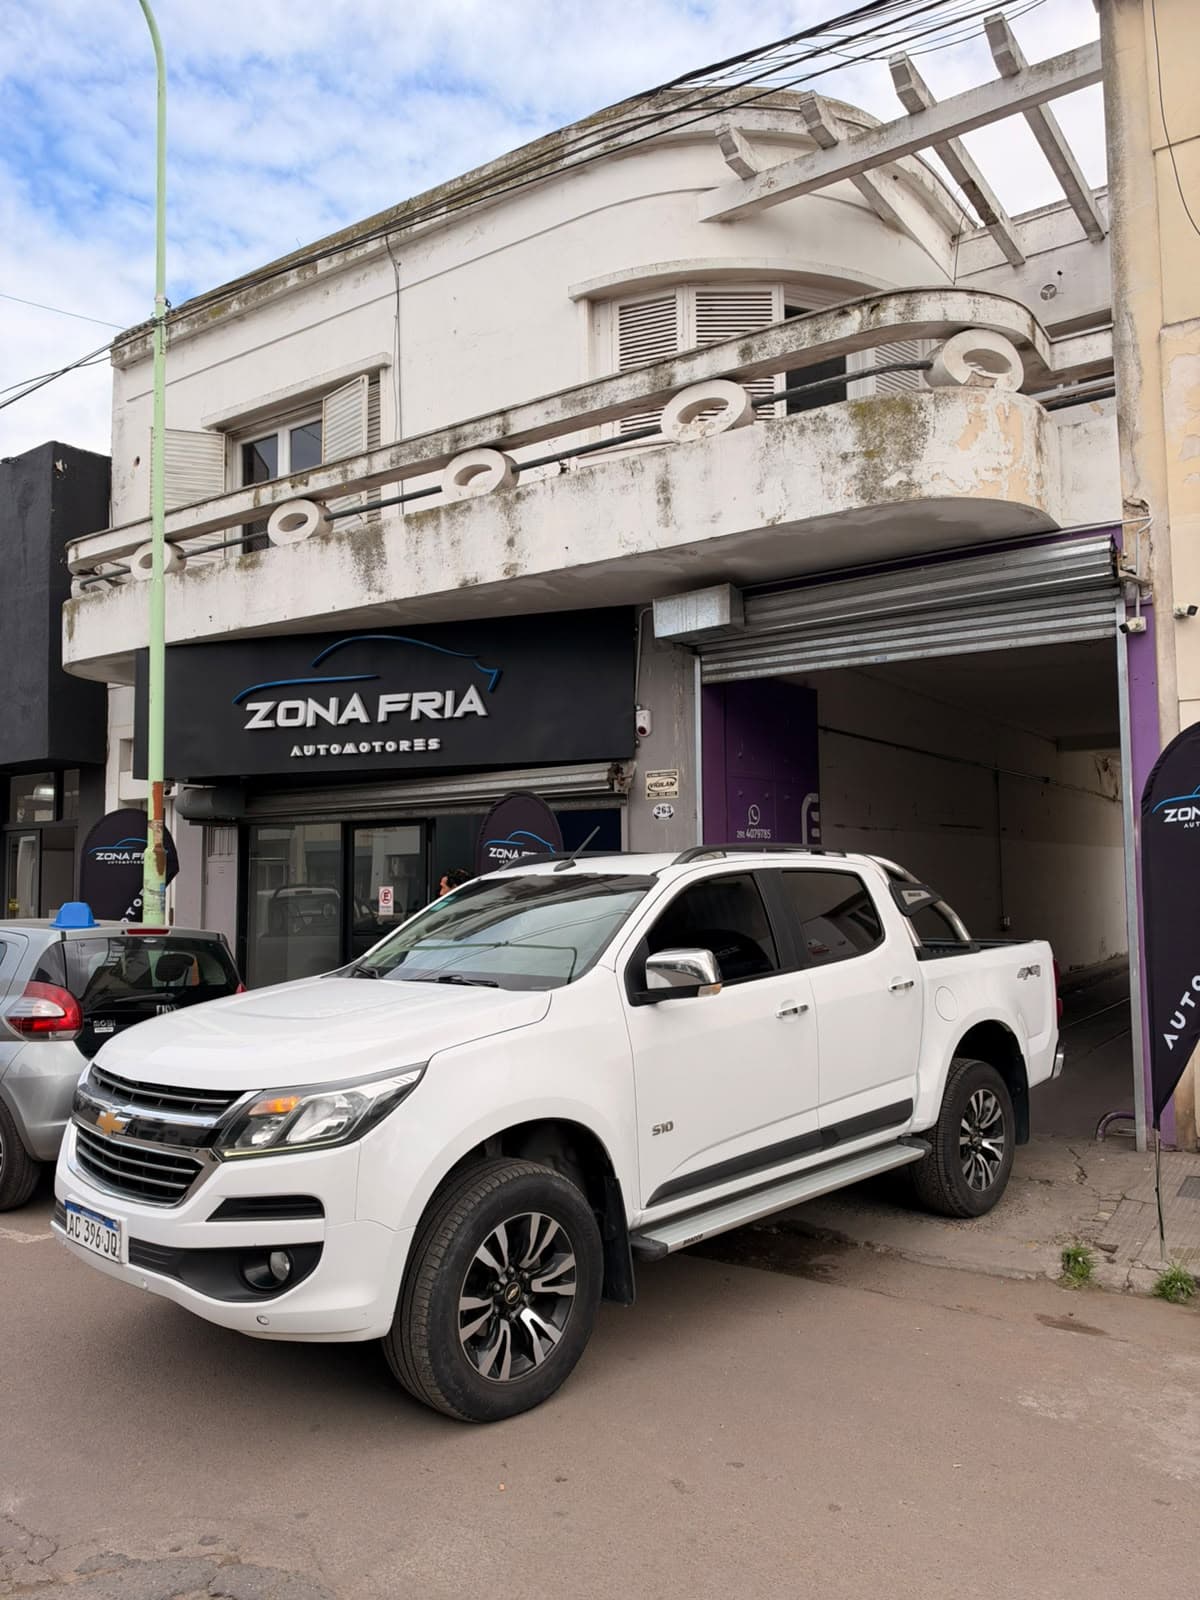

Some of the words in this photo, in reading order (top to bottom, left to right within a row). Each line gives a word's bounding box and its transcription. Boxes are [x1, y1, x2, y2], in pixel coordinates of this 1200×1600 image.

[243, 692, 371, 730] ZONA
[377, 684, 488, 723] FRIA
[290, 738, 441, 757] AUTOMOTORES
[656, 806, 672, 814] 263
[95, 852, 130, 861] ZONA
[488, 847, 520, 859] ZONA
[1163, 974, 1200, 1051] AUTO
[652, 1121, 674, 1136] S10
[67, 1214, 81, 1238] AC
[84, 1220, 101, 1249] 396
[104, 1230, 119, 1257] JQ
